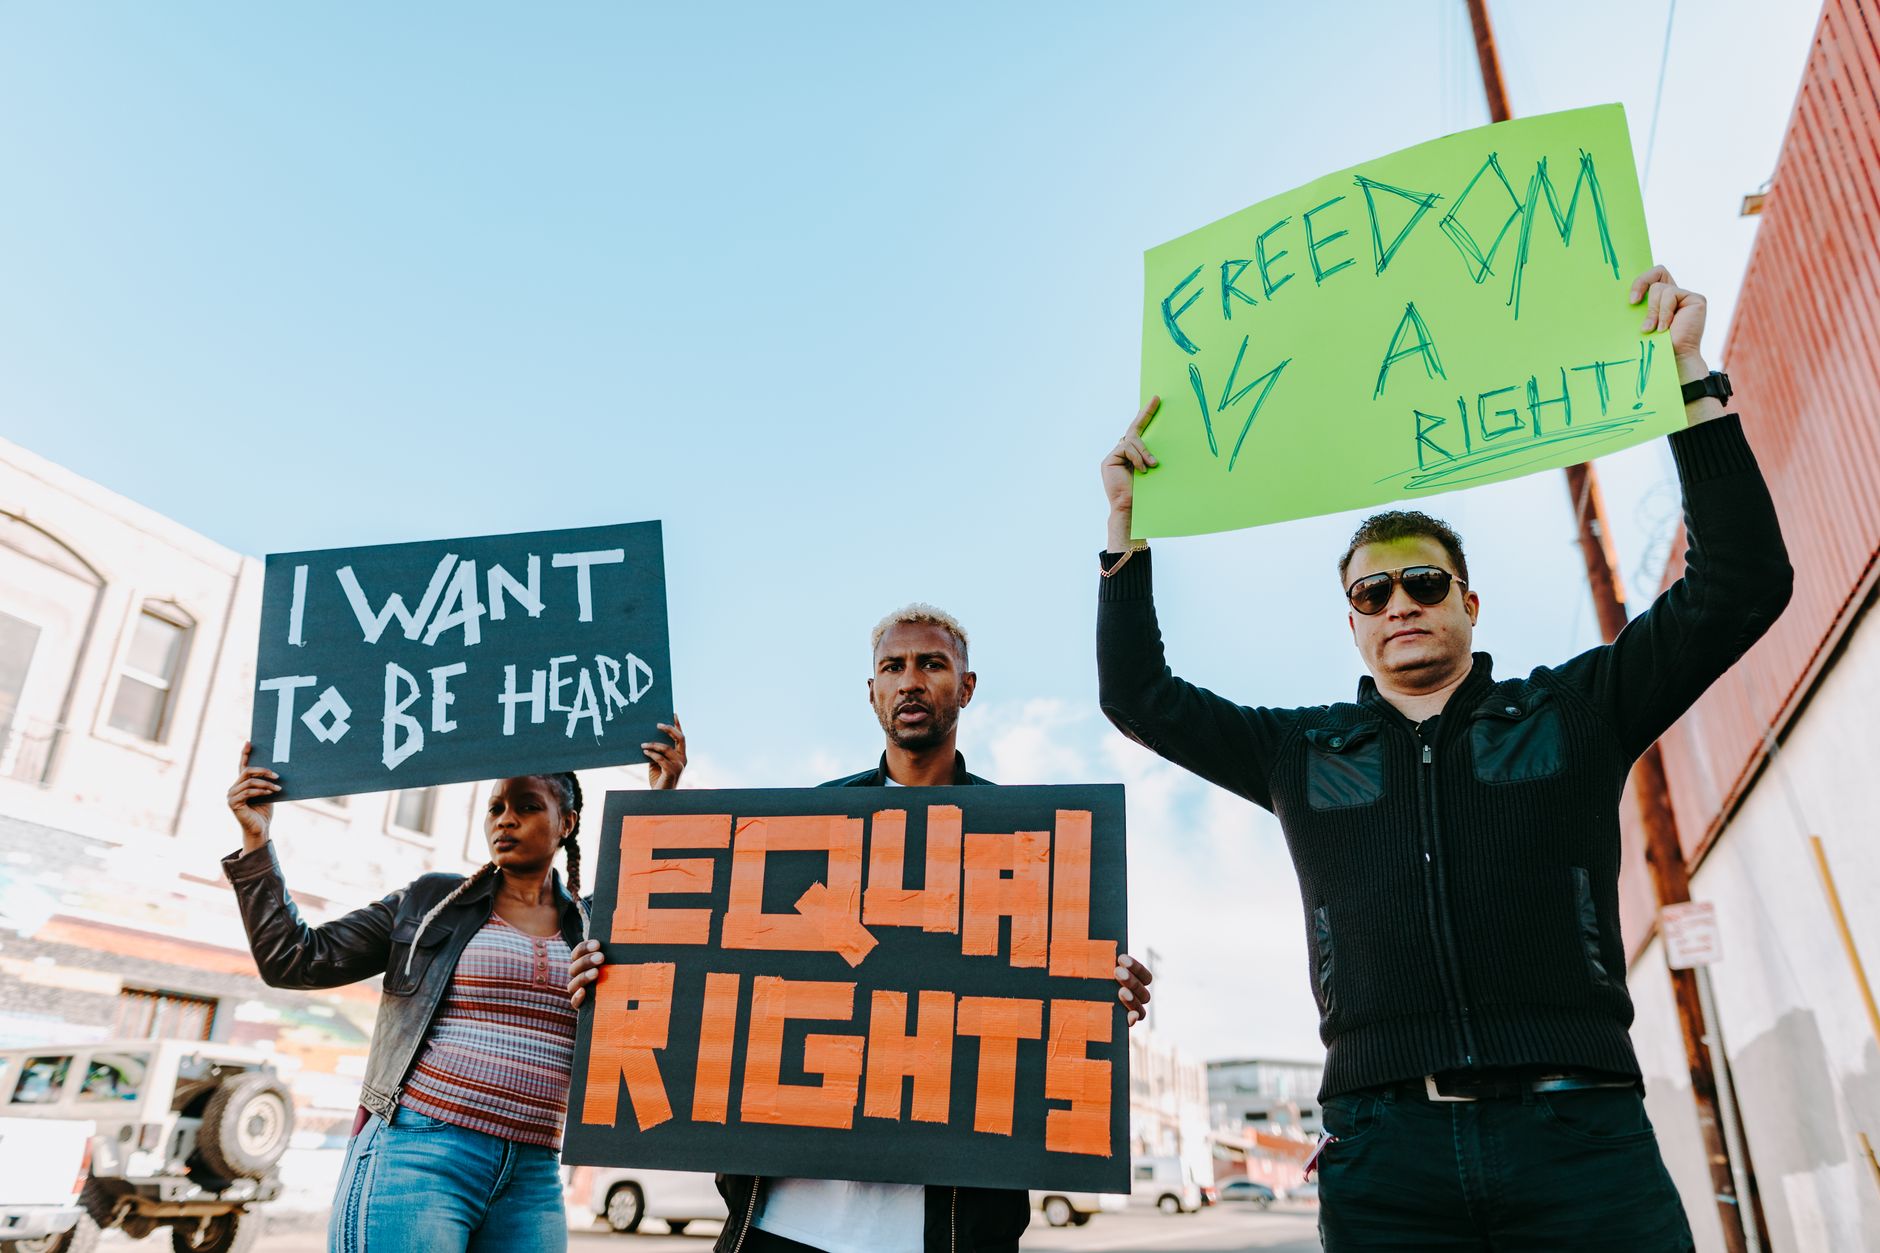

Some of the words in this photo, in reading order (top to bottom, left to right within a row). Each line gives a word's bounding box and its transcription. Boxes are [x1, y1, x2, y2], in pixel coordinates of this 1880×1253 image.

[1160, 148, 1621, 355] FREEDOM
[1188, 334, 1292, 472] IS
[1373, 301, 1447, 401] A
[1413, 340, 1656, 471] RIGHT!
[288, 564, 309, 647] I
[336, 548, 625, 647] WANT
[259, 674, 352, 764] TO
[382, 661, 467, 771] BE
[498, 652, 654, 745] HEARD
[610, 804, 1118, 980] EQUAL
[581, 961, 1115, 1157] RIGHTS
